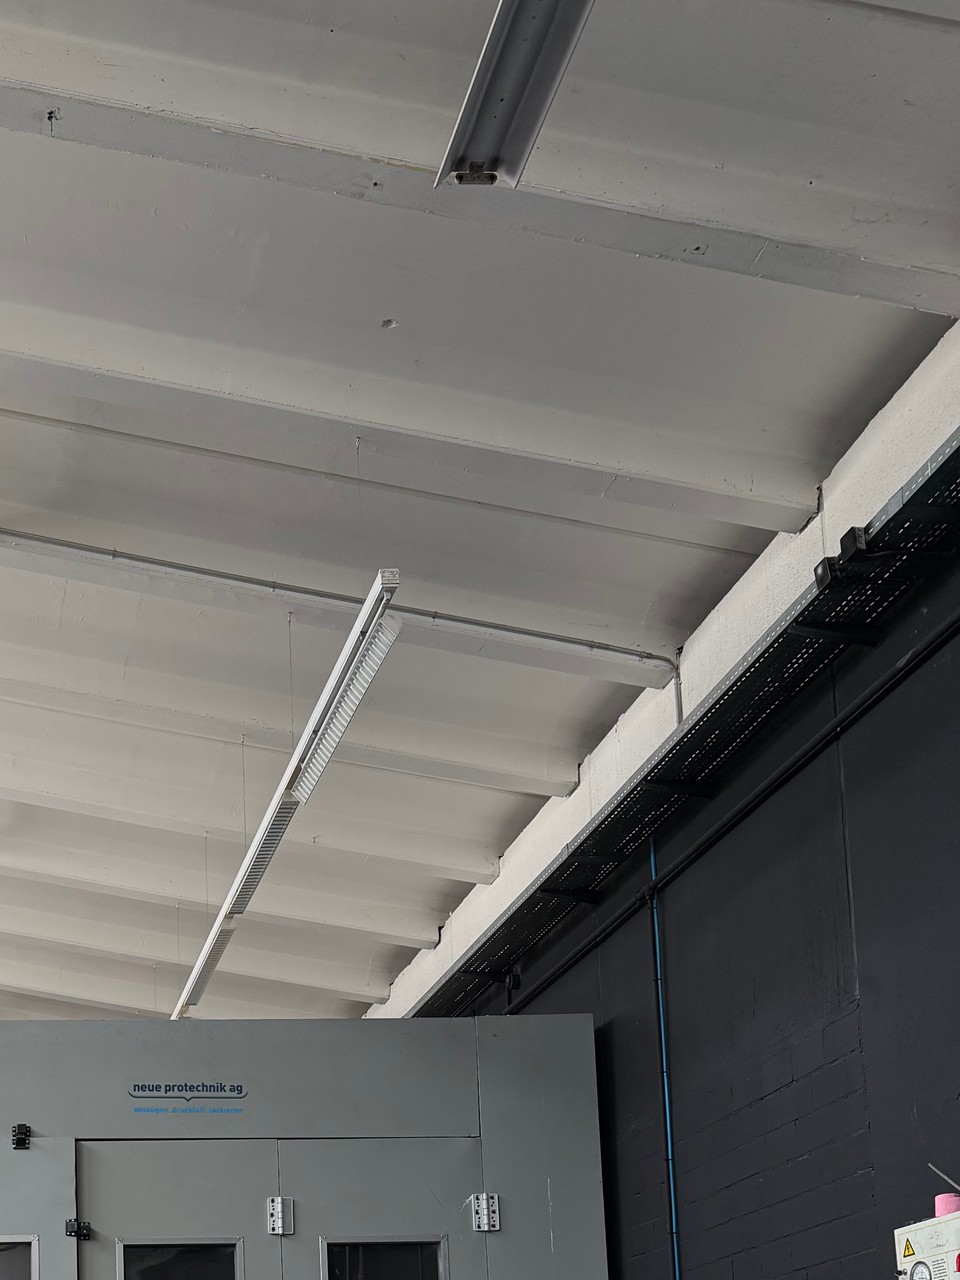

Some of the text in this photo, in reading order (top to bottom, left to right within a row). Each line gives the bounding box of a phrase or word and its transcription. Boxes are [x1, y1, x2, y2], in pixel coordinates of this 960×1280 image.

[133, 1082, 243, 1095] neue protechnik ag
